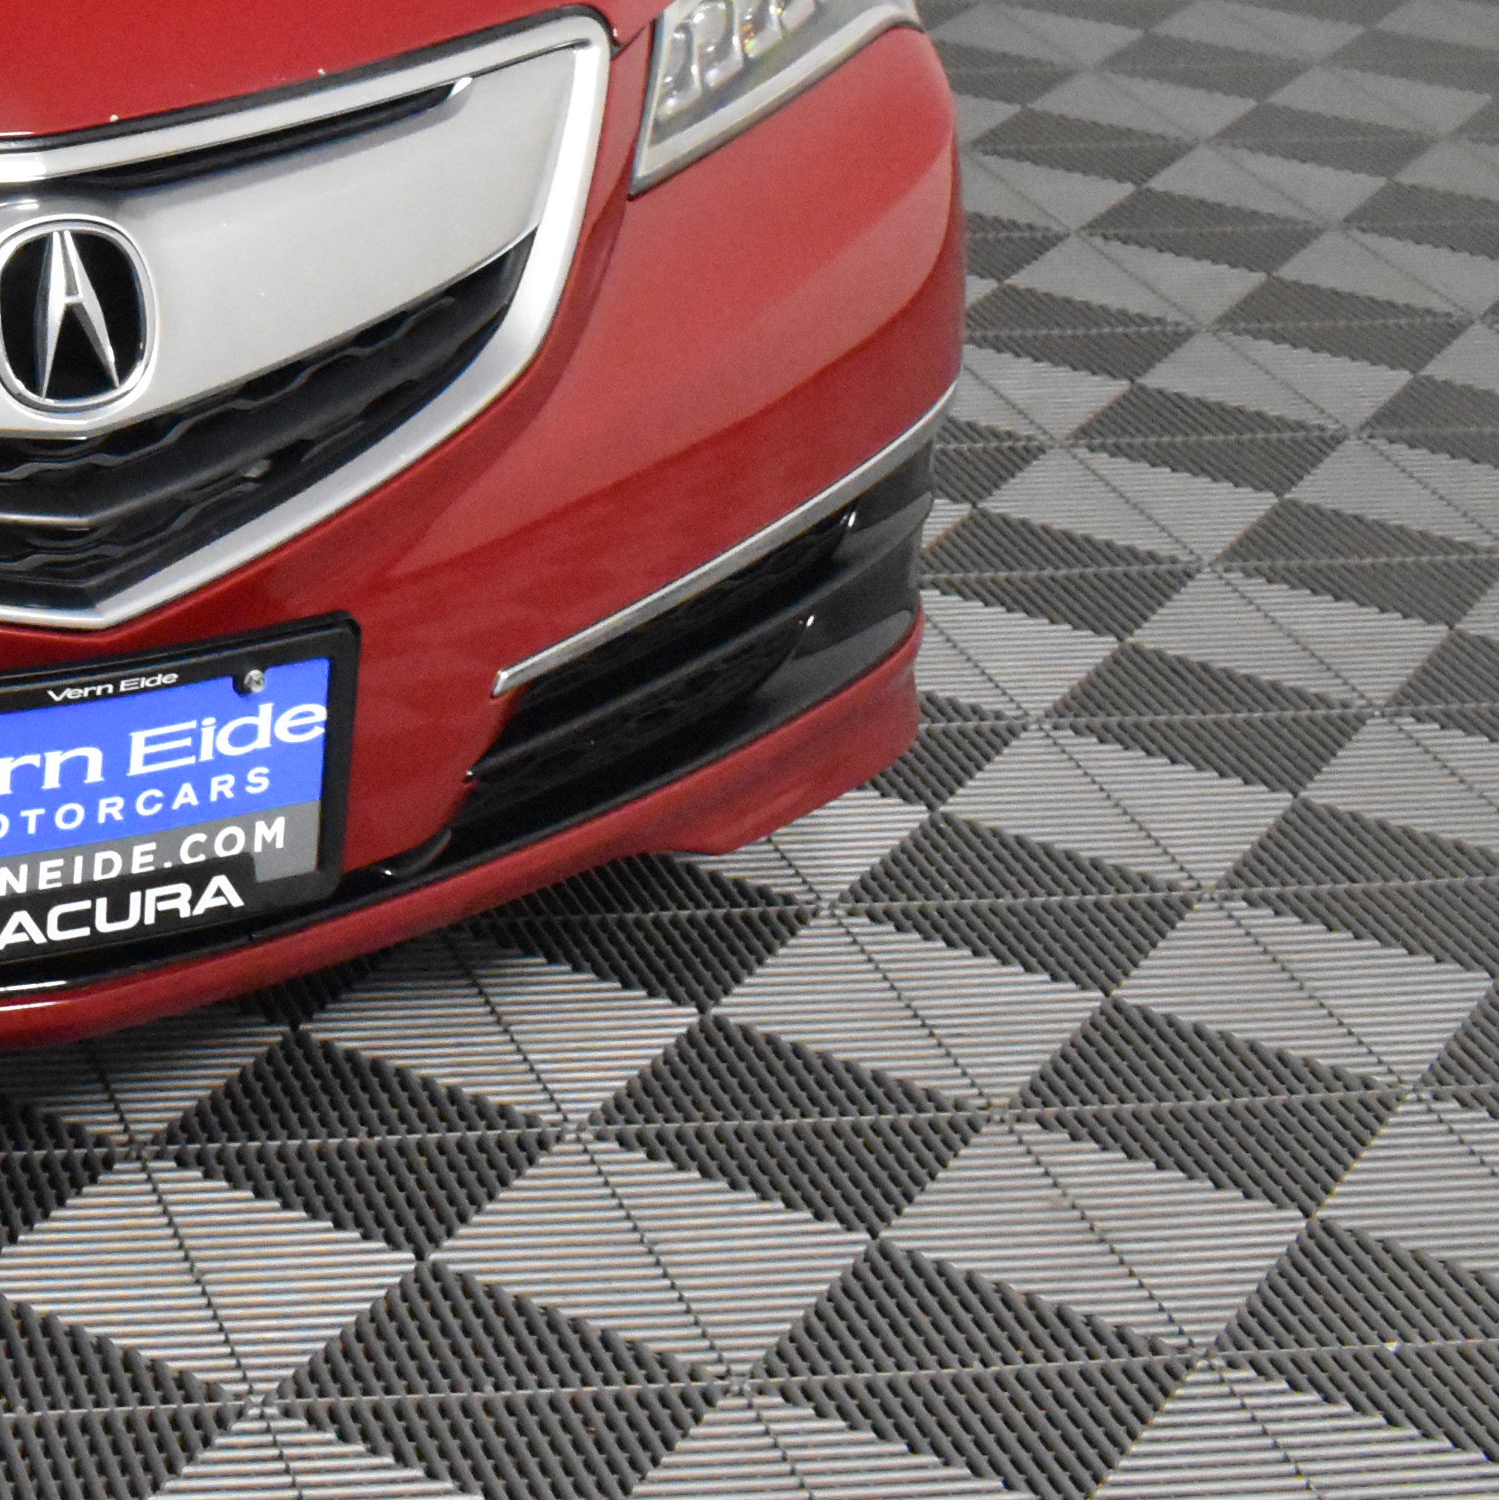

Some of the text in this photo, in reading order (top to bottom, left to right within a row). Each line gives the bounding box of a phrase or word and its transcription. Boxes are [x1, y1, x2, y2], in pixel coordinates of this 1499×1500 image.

[47, 671, 179, 702] Vern Eide
[127, 702, 328, 777] Eide
